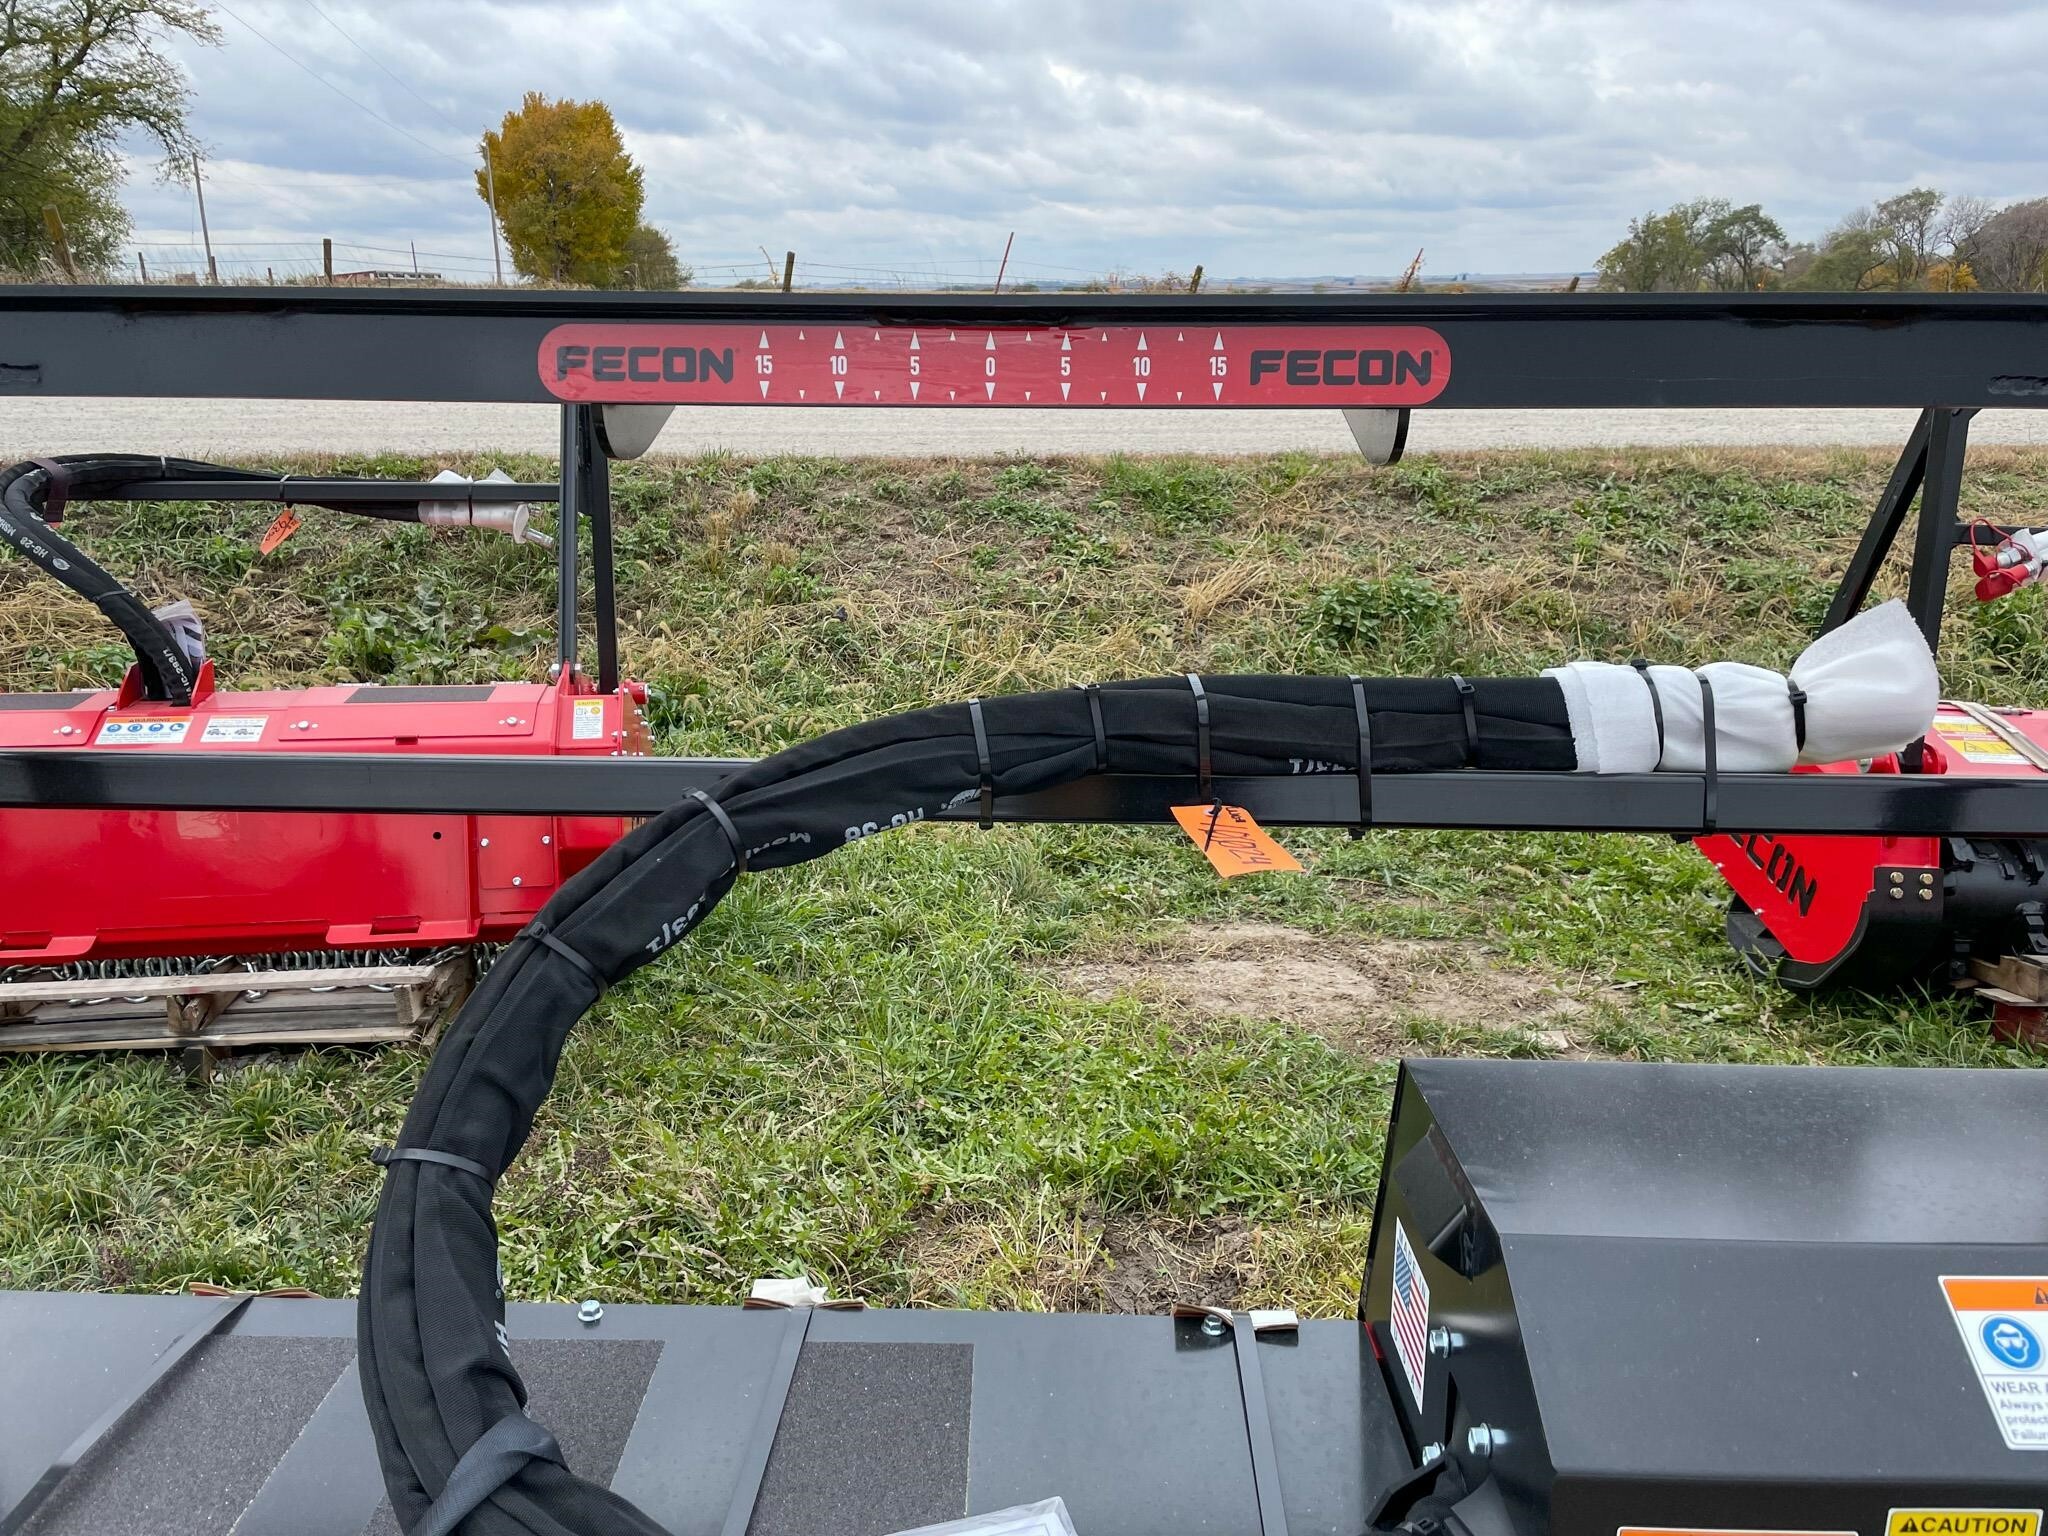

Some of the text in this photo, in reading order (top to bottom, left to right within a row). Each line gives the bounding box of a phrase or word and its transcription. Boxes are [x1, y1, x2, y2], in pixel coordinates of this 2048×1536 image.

[557, 346, 1432, 386] FECON 15 10 5 0 5 10 15 FECON
[1990, 1381, 2043, 1394] WEAR
[1920, 1516, 2029, 1534] CAUTION
